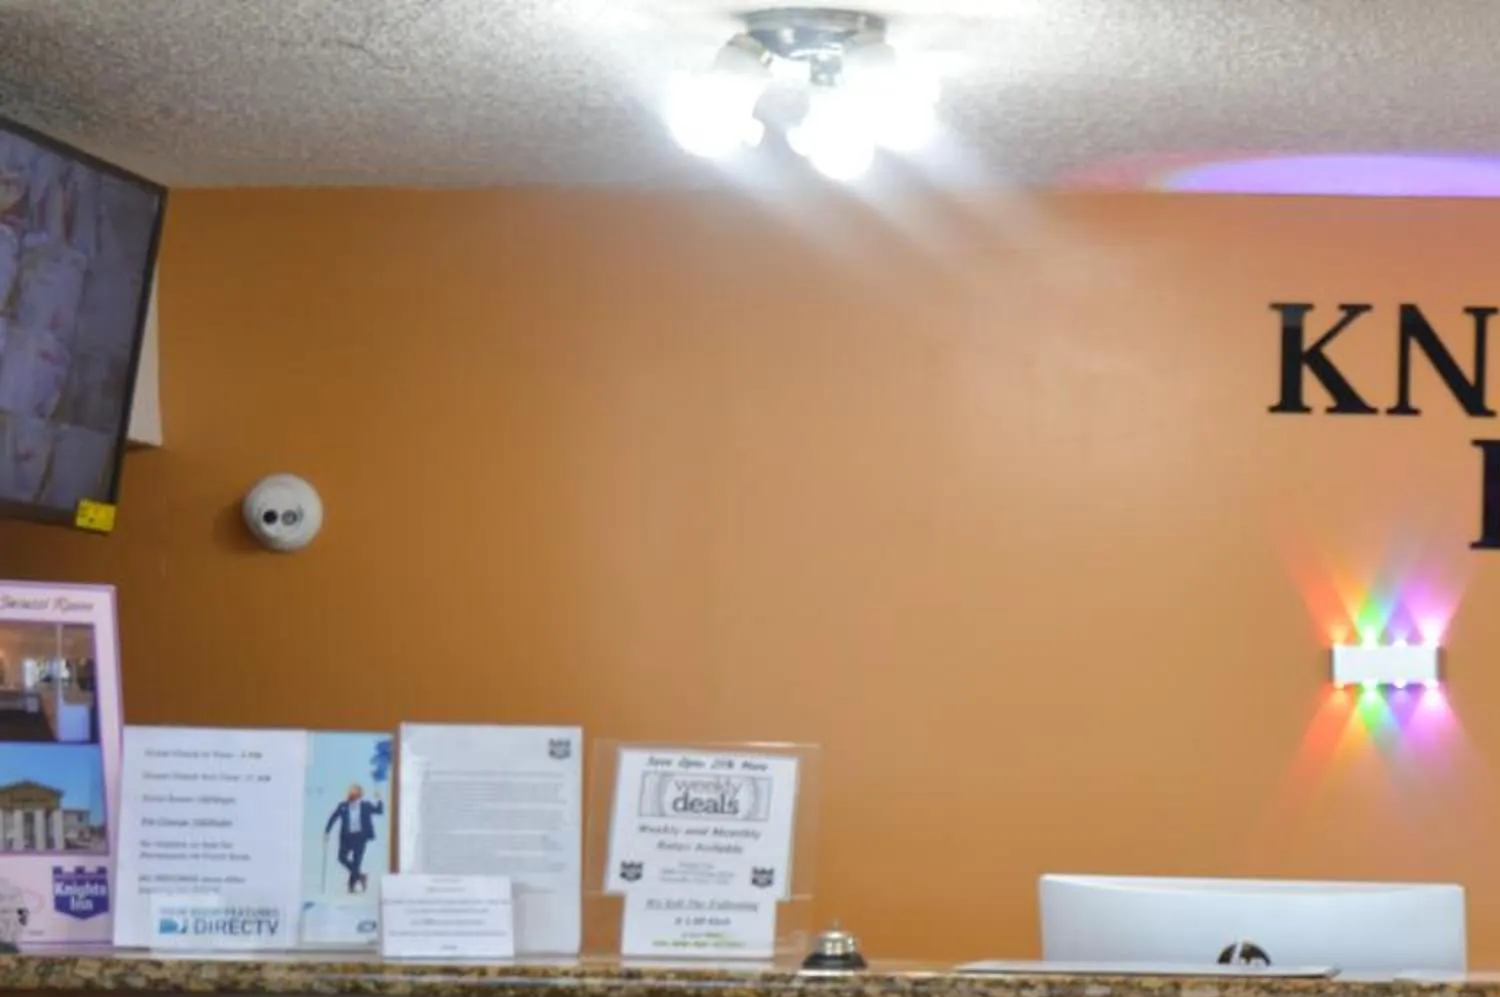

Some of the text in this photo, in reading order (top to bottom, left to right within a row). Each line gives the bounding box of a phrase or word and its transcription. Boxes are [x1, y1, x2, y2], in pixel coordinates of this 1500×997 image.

[672, 791, 740, 815] deals
[55, 880, 107, 899] Knights
[70, 896, 94, 911] Inn
[193, 918, 280, 936] DIRECTV
